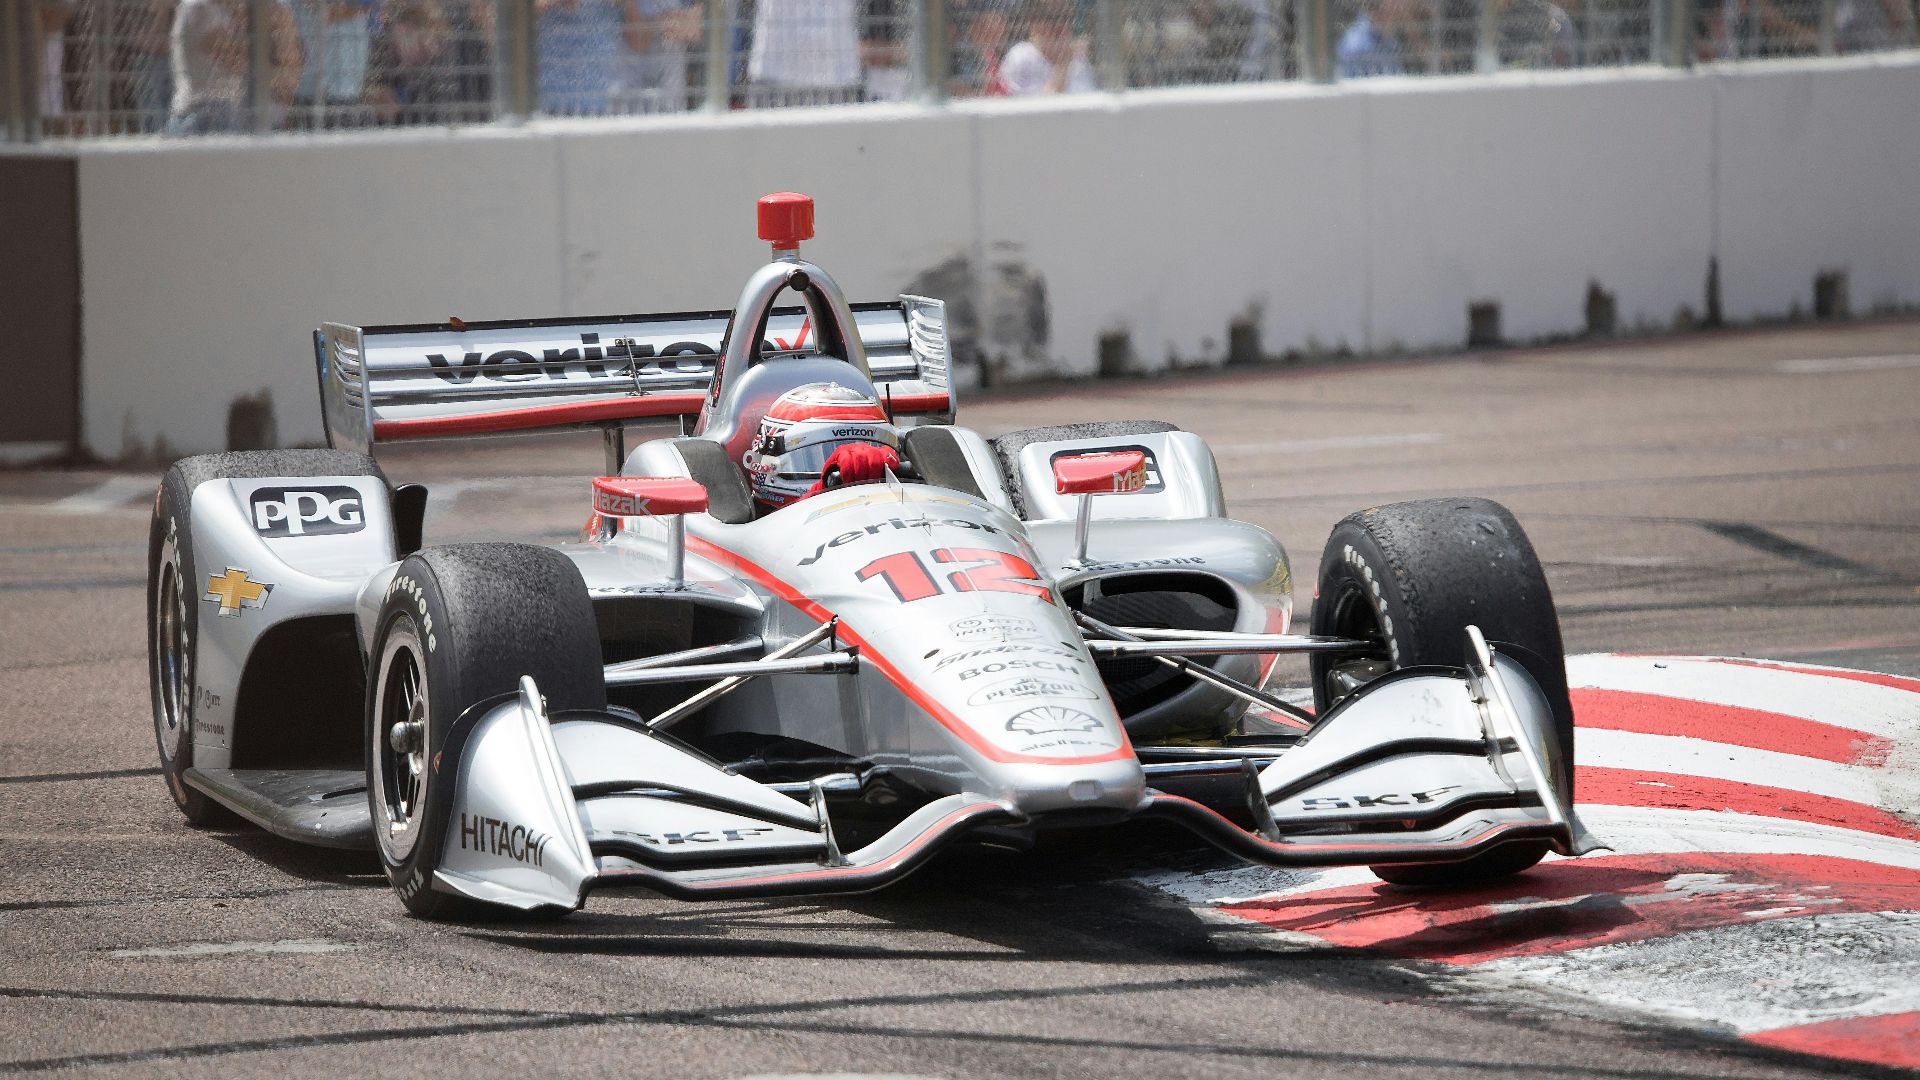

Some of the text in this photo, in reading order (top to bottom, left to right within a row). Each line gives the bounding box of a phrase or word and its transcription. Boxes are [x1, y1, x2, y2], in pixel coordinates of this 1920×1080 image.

[831, 426, 874, 437] verizon
[254, 491, 362, 534] PPG
[592, 488, 651, 515] Mazak
[854, 547, 1057, 606] 12
[386, 575, 437, 653] Firestone
[958, 659, 1080, 681] BOSCH
[1302, 785, 1462, 810] SKF
[461, 813, 551, 867] HITACHI
